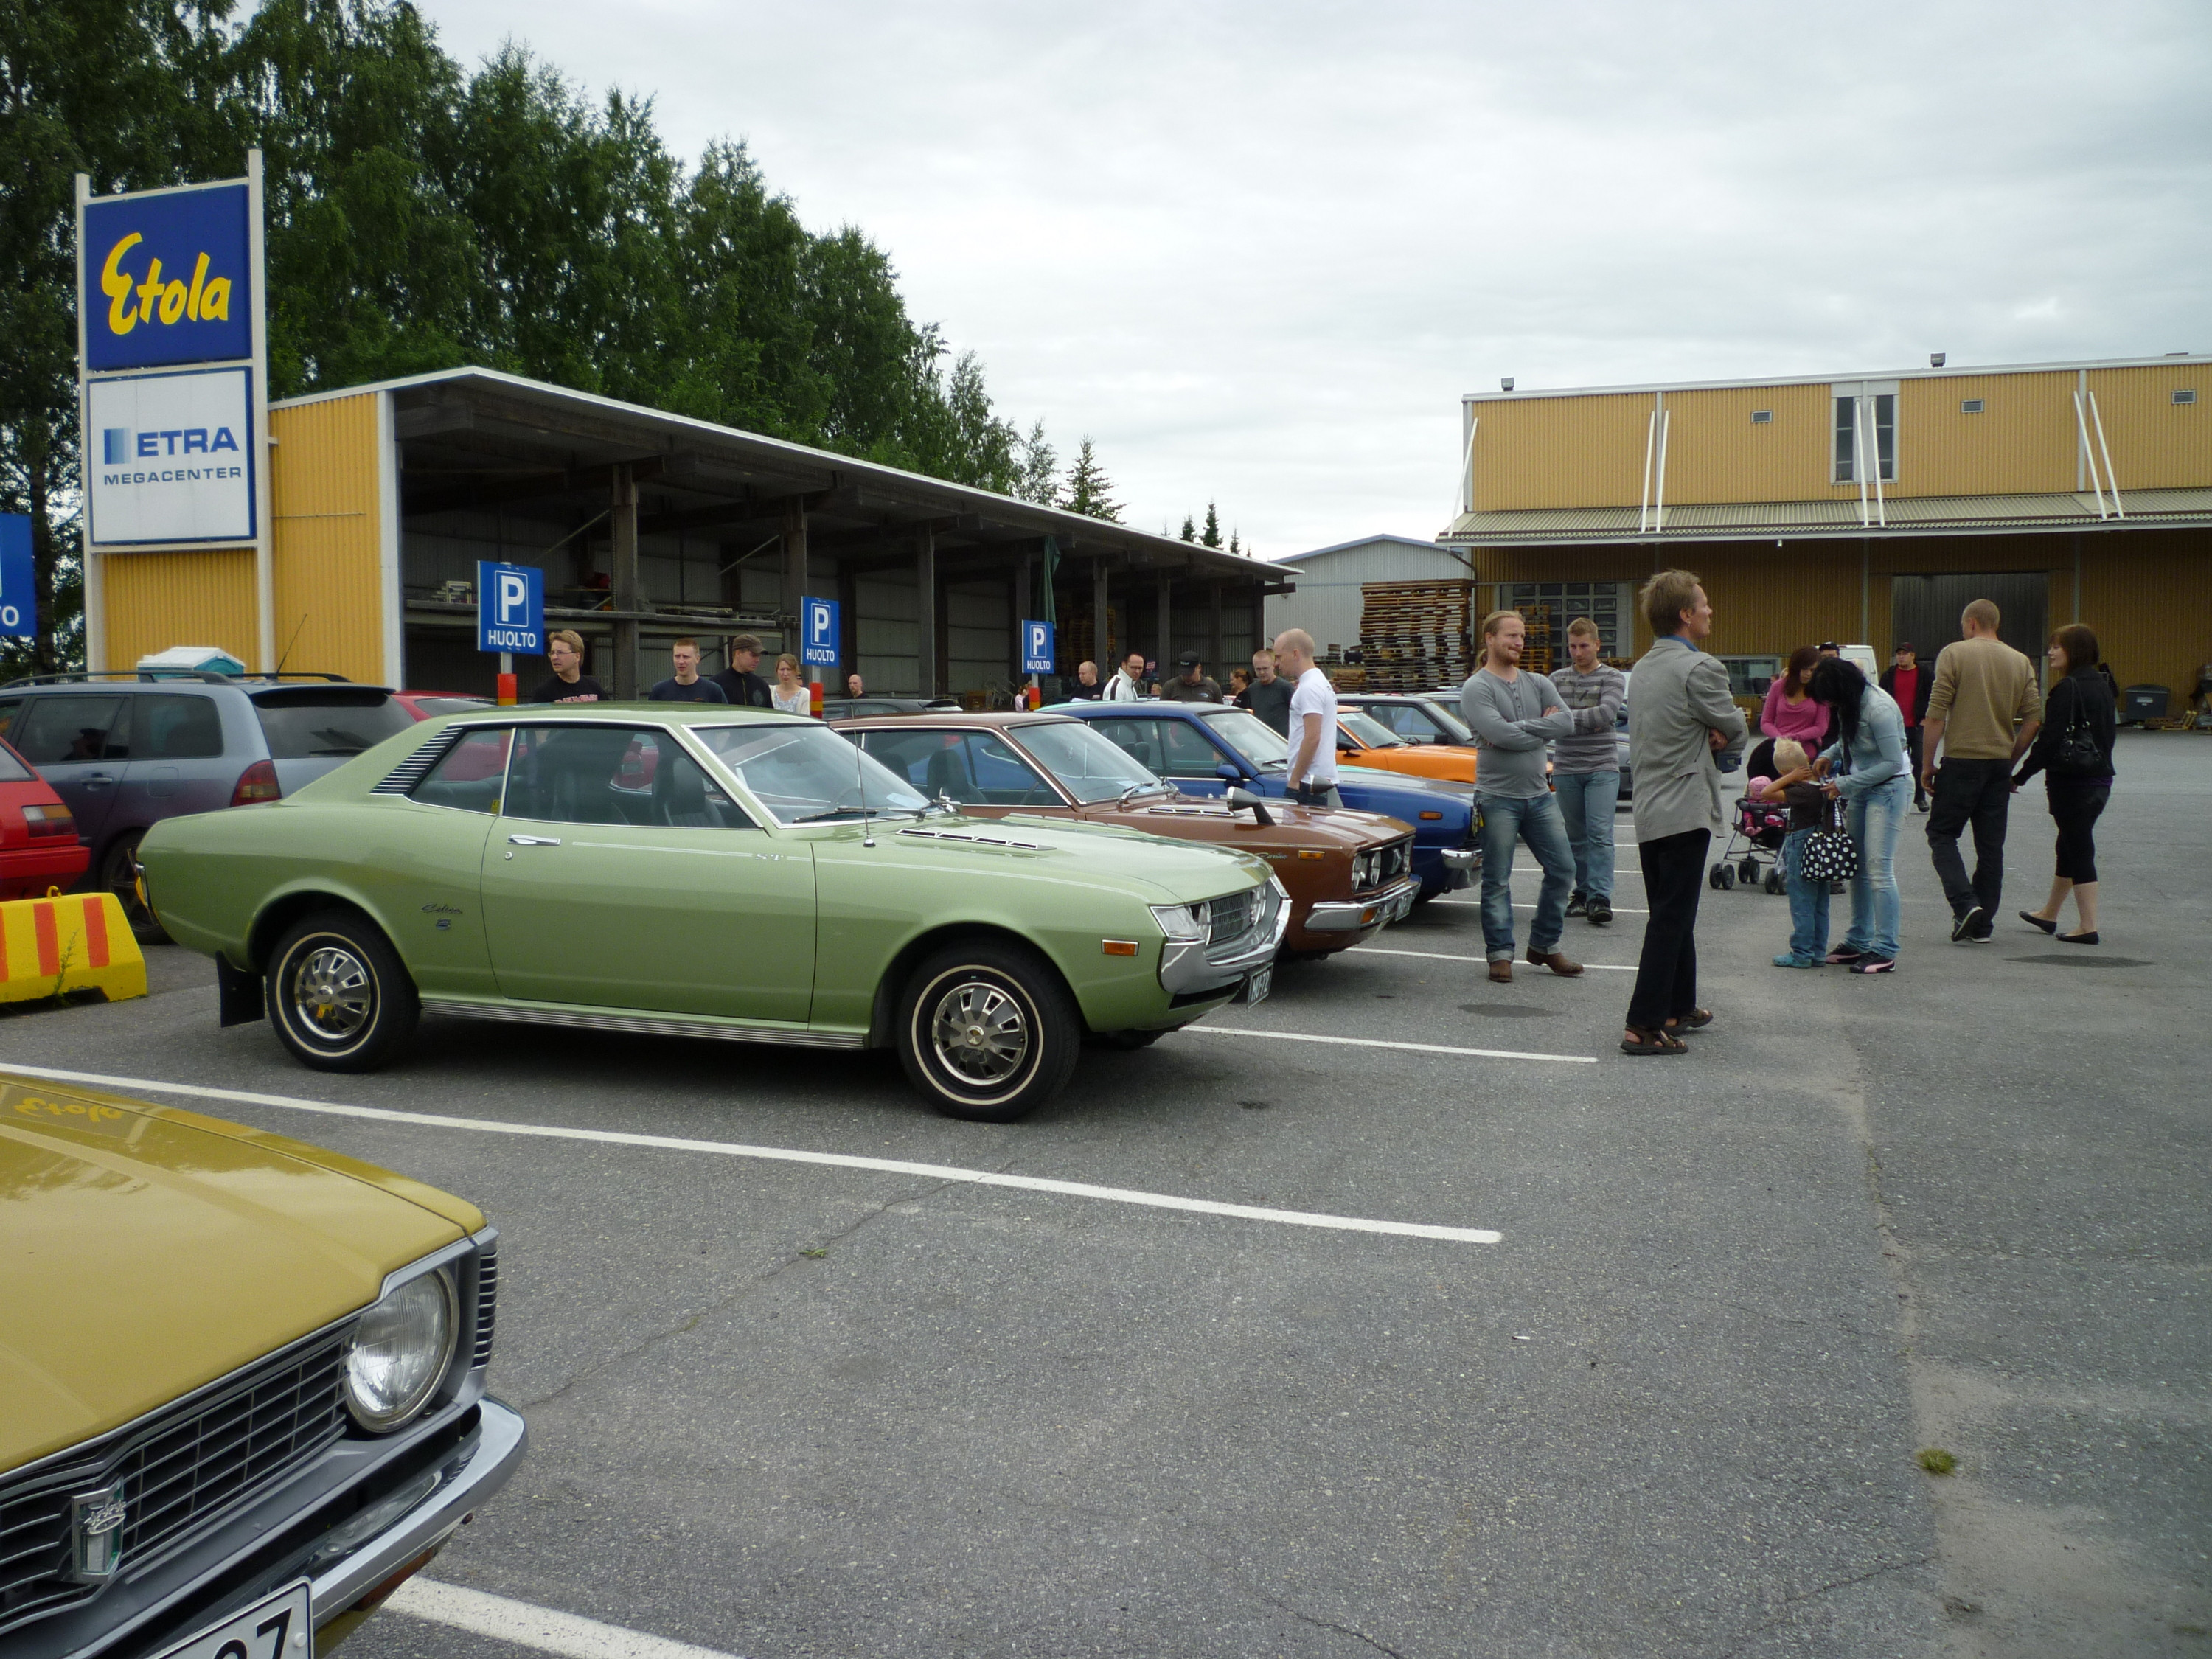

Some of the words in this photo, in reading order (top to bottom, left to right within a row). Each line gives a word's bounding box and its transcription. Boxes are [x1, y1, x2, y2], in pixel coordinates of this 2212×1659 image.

[101, 232, 232, 335] Etola
[136, 426, 240, 457] ETRA
[104, 467, 241, 485] MEGACENTER
[501, 575, 525, 622] P
[488, 629, 536, 648] HUOLTO
[814, 607, 829, 642] P
[807, 648, 835, 662] HUOLTO
[1033, 627, 1045, 655] P
[1027, 660, 1051, 670] HUOLTO
